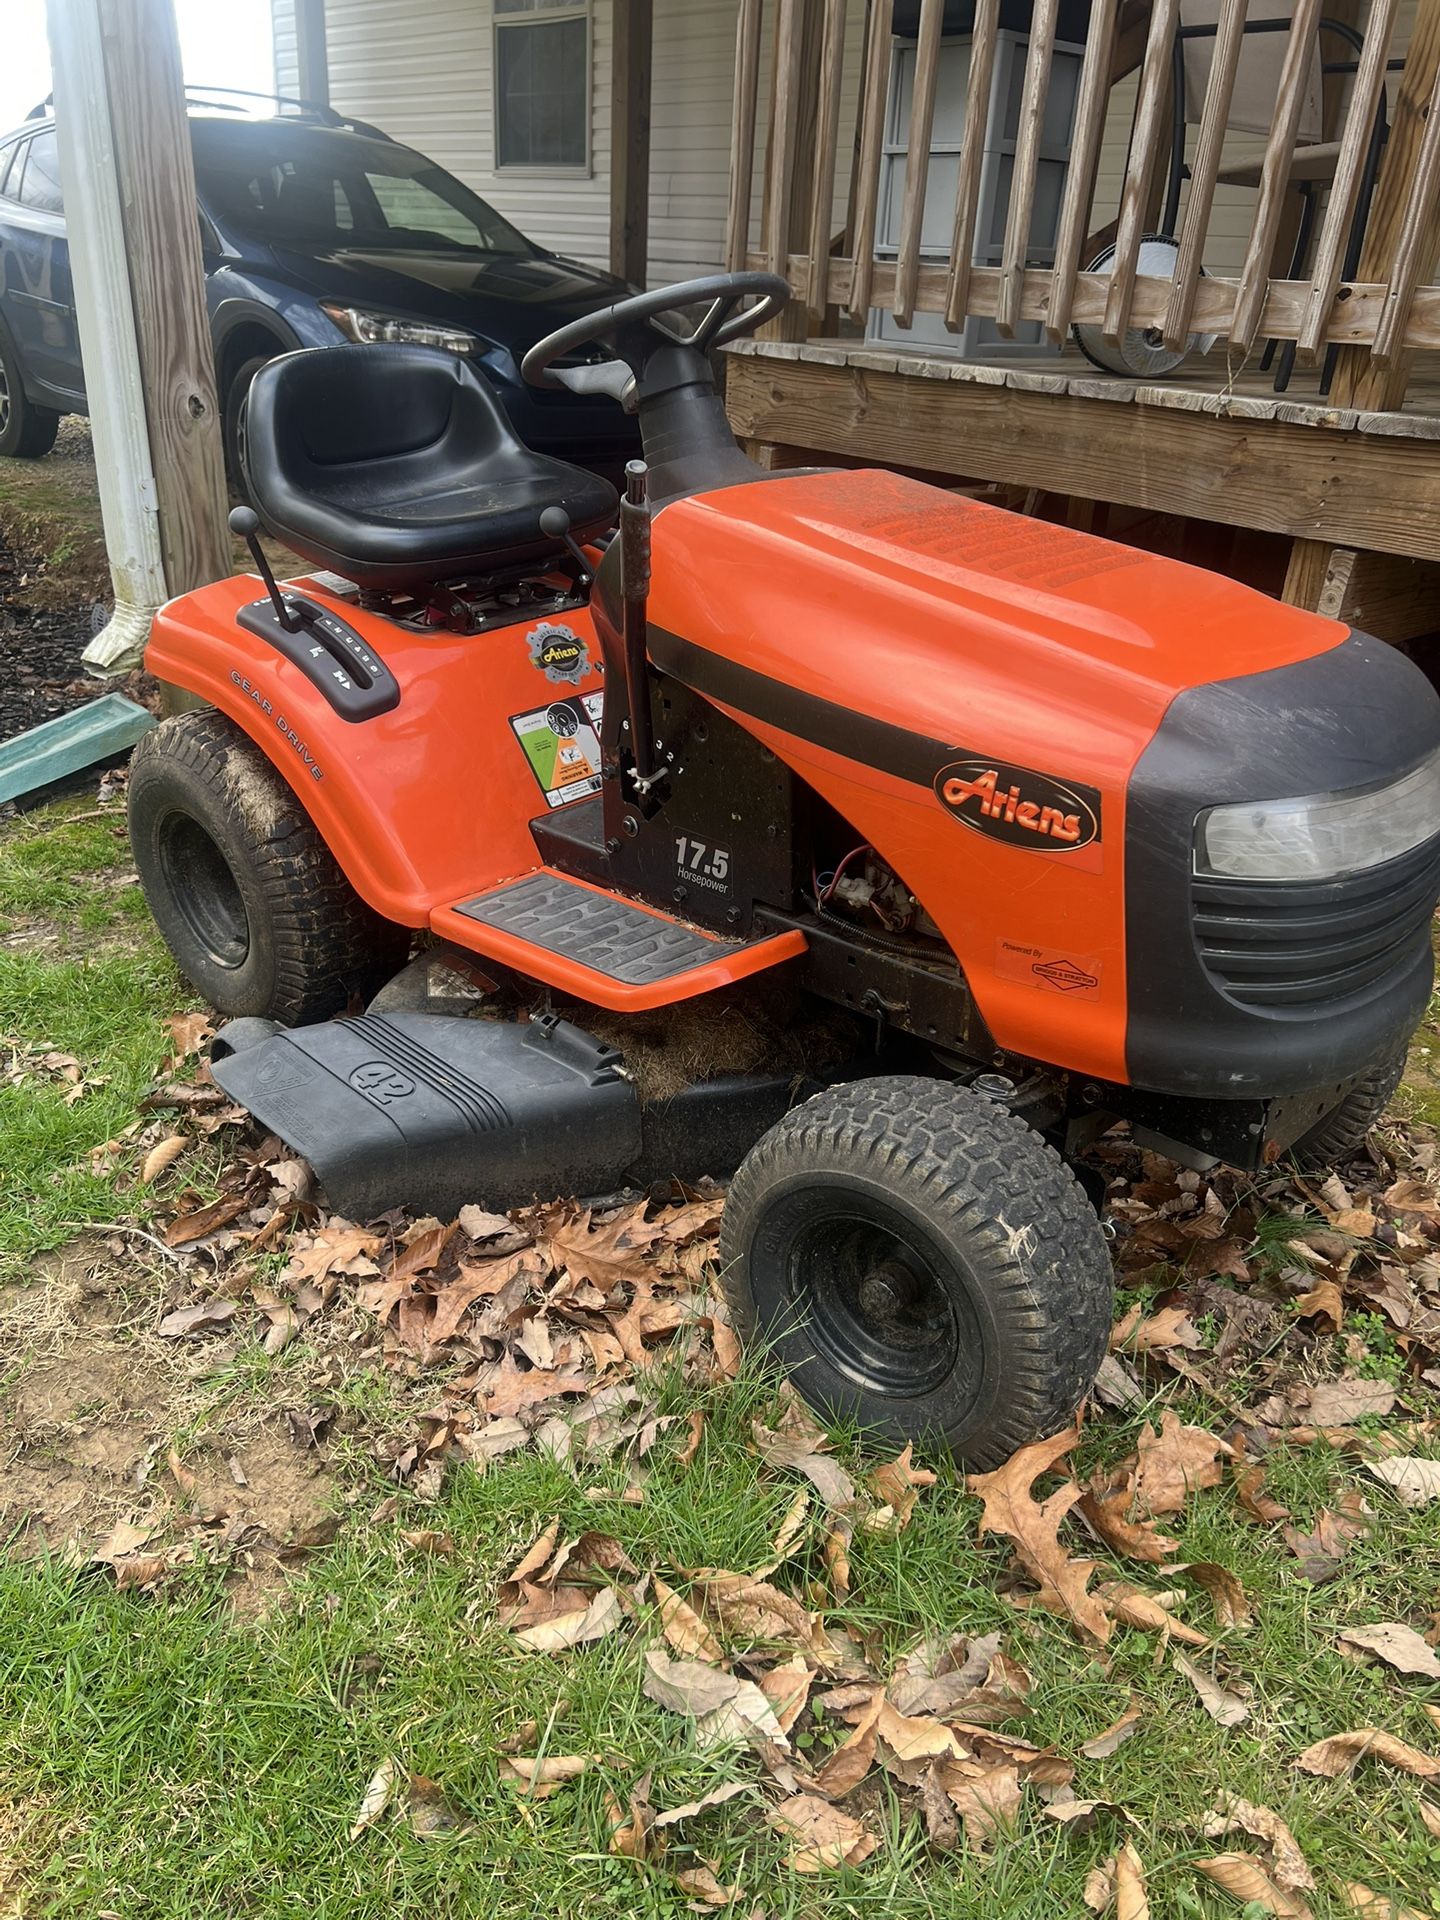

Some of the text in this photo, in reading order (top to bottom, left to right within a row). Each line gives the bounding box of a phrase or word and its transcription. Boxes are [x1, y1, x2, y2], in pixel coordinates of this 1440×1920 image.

[543, 647, 579, 662] Ariens
[229, 669, 273, 716] GEAR
[622, 720, 630, 730] 6
[275, 715, 324, 782] DRIVE
[656, 739, 663, 750] 3
[666, 751, 674, 762] 2
[942, 769, 1081, 843] Ariens
[675, 836, 729, 879] 17.5
[677, 866, 729, 894] Horsepower
[1002, 942, 1043, 958] Powered By
[1063, 973, 1095, 985] STRATTON
[354, 1068, 410, 1106] 42
